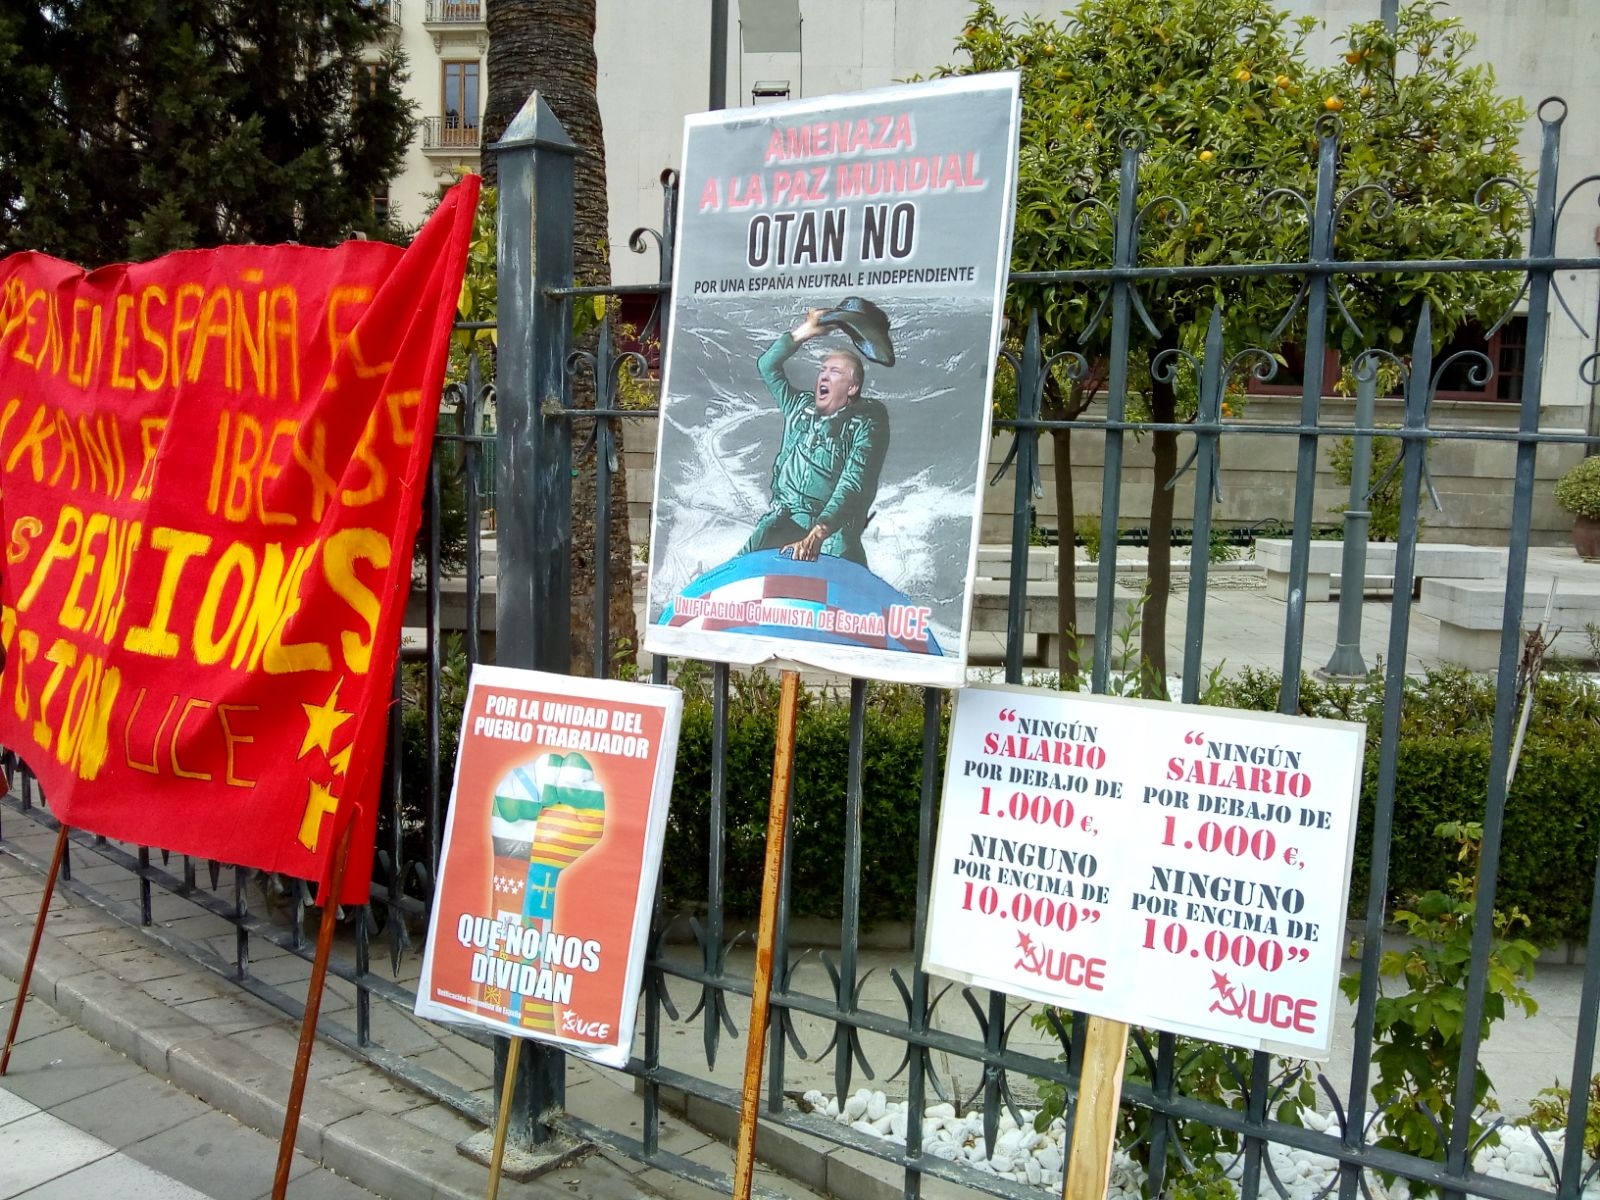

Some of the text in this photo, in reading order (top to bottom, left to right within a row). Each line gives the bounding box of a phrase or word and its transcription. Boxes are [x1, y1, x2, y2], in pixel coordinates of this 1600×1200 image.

[765, 113, 913, 162] AMENAZA
[699, 151, 984, 210] A LA PAZ MUNDIAL
[747, 202, 916, 268] OTAN NO
[694, 266, 975, 294] POR UNA ESPAÑA NEUTRAL E INDEPENDIENTE
[111, 269, 300, 402] ESPAÑA
[208, 409, 337, 524] IBEX
[17, 505, 392, 674] PENSIONES
[674, 597, 931, 640] UNIFICACIÓN COMUNISTA DE ESPAÑA UCE
[125, 687, 260, 788] UCE
[485, 695, 643, 734] POR LA UNIDAD DEL
[474, 717, 650, 759] PUEBLO TRABAJADOR
[984, 732, 1106, 770] SALARIO
[963, 760, 1123, 799] POR DEBAJO DE
[1166, 757, 1311, 798] SALARIO
[979, 787, 1074, 829] 1.000
[1143, 786, 1331, 830] POR DEBAJO DE
[969, 833, 1097, 879] NINGUNO
[1161, 815, 1276, 861] 1.000
[953, 858, 1110, 904] POR ENCIMA DE
[1150, 866, 1304, 914] NINGUNO
[1131, 893, 1319, 942] POR ENCIMA DE
[457, 913, 601, 973] QUE NO NOS
[471, 951, 573, 1005] DIVIDAN
[1046, 948, 1107, 991] UCE
[577, 1020, 610, 1039] UCE
[1247, 989, 1318, 1034] UCE
